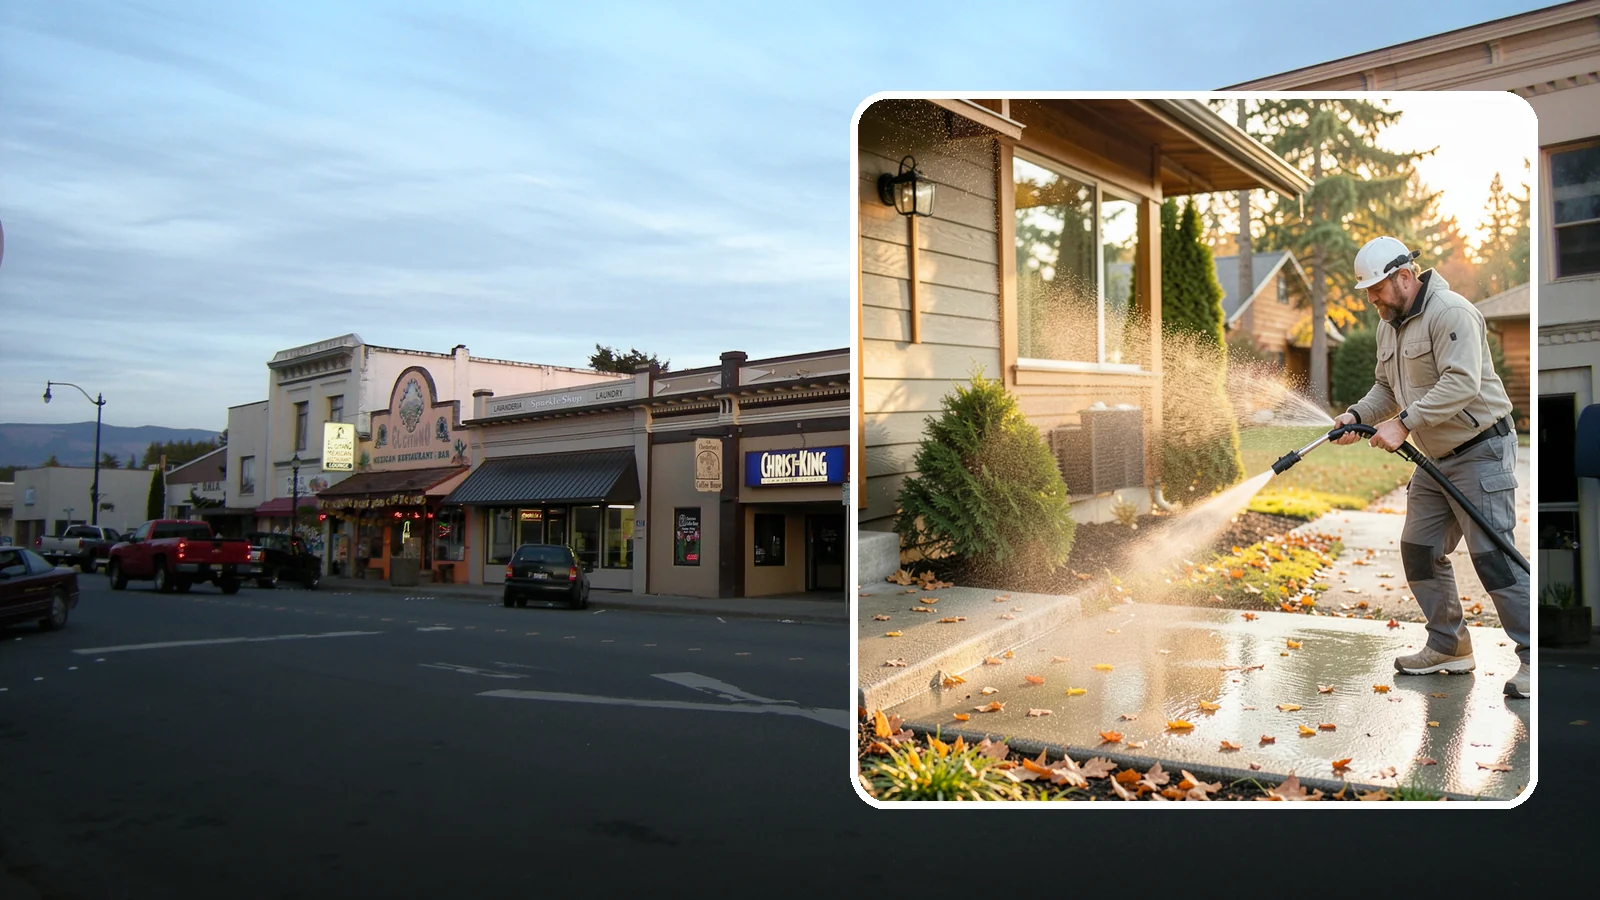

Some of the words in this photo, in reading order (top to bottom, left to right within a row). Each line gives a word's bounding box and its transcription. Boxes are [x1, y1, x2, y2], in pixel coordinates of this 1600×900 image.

[493, 402, 523, 413] LAVANDERIA
[530, 397, 561, 409] Sparkle
[562, 394, 583, 404] Shop
[595, 389, 623, 400] LAUNDRY
[373, 455, 396, 464] MEXICAN
[397, 452, 433, 462] RESTAURANT
[437, 450, 450, 459] BAR
[760, 452, 798, 478] CHRIST
[799, 450, 827, 476] KING
